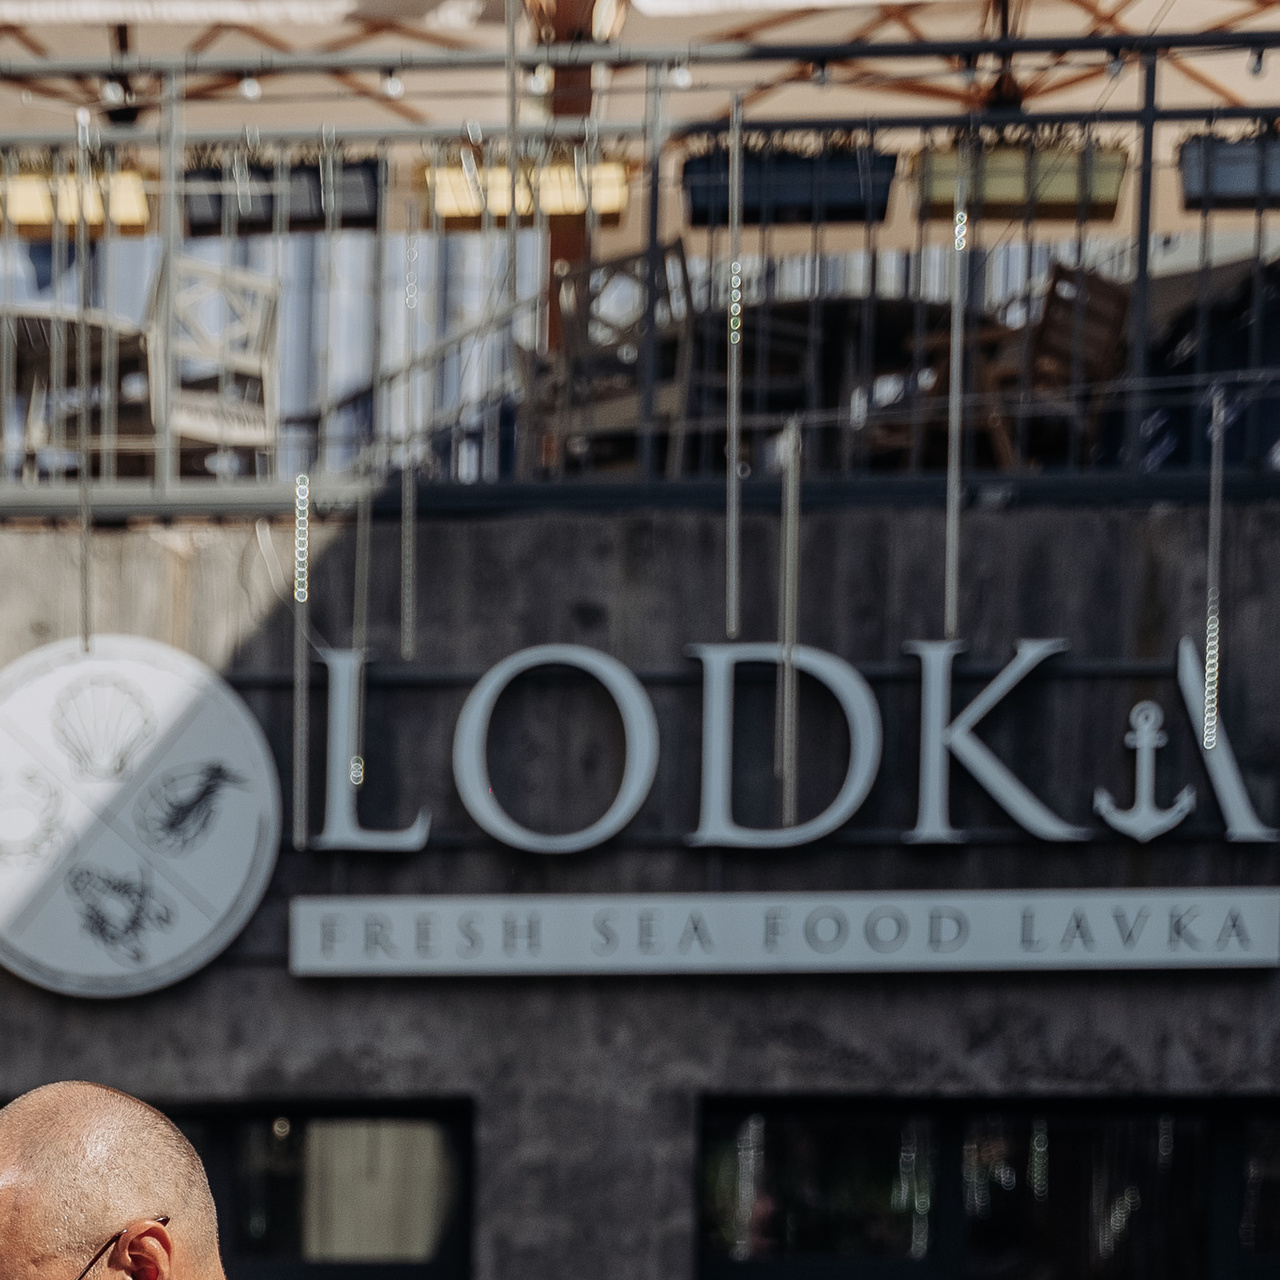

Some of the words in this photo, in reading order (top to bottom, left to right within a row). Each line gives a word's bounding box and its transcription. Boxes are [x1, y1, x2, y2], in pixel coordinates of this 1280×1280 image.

[320, 909, 543, 961] FRESH
[591, 907, 715, 958] SEA
[762, 904, 971, 955] FOOD
[1019, 904, 1253, 954] LAVKA
